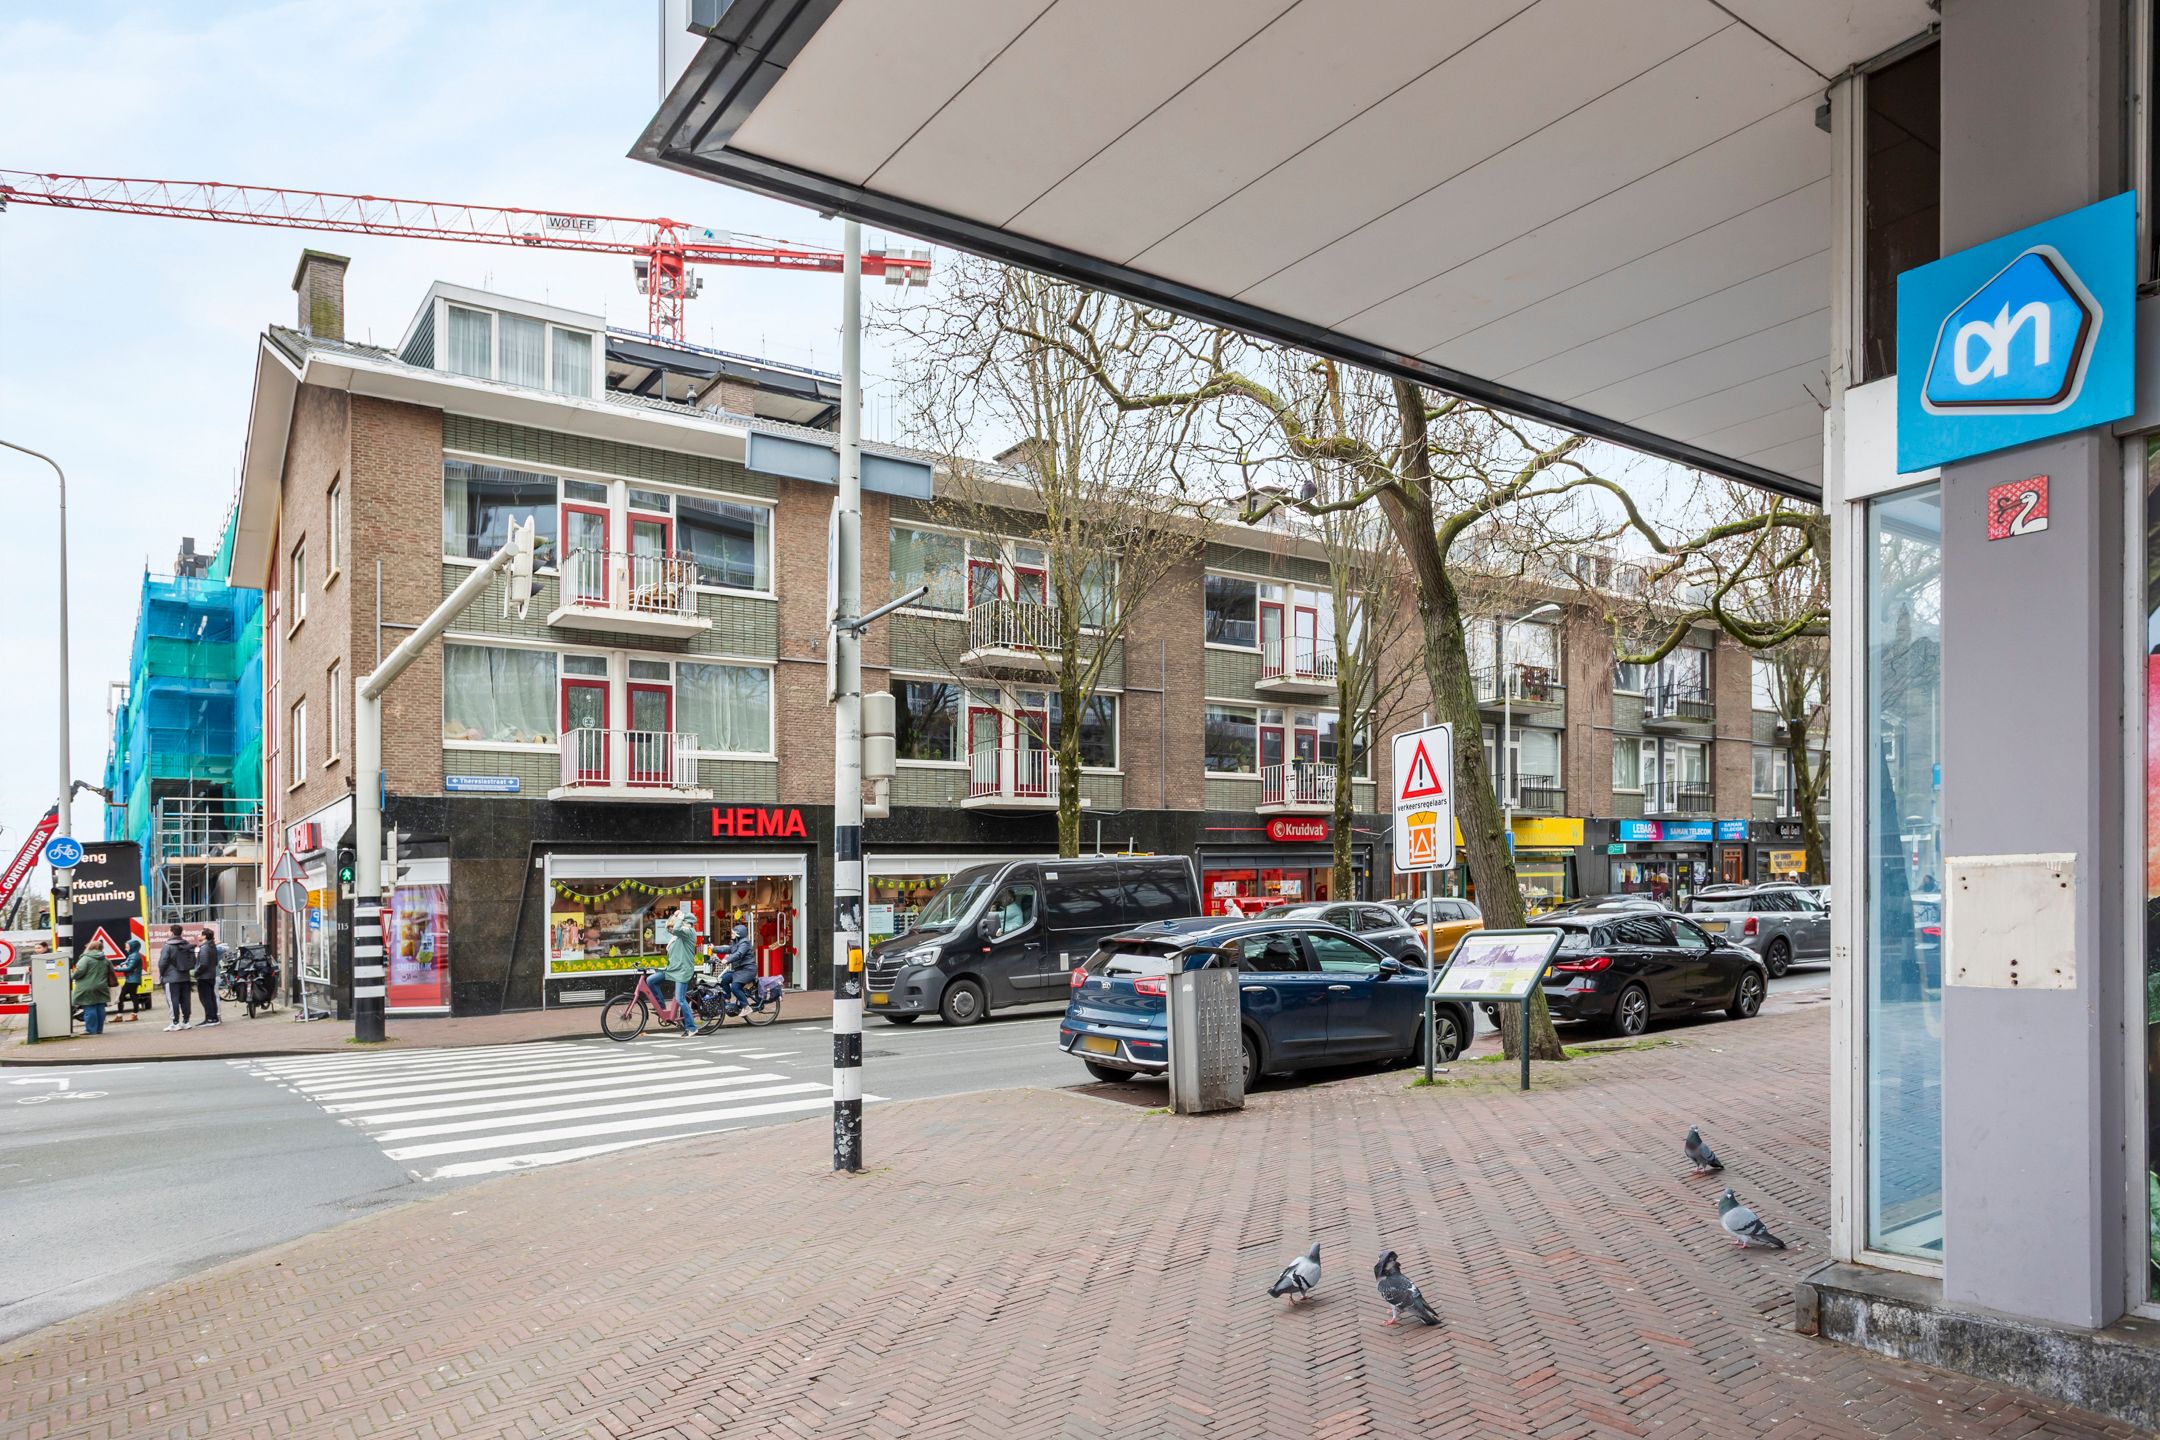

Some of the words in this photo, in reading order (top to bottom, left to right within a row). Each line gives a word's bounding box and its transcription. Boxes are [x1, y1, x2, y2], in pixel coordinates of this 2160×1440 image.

[460, 777, 507, 785] Theresiastraat
[1397, 799, 1447, 811] verkeersregelaars
[711, 806, 807, 837] HEMA
[1285, 823, 1324, 836] Kruidvat
[1632, 823, 1657, 834] LEBARA
[1689, 827, 1712, 835] TELECOM
[2, 830, 48, 891] GORTENMULDER
